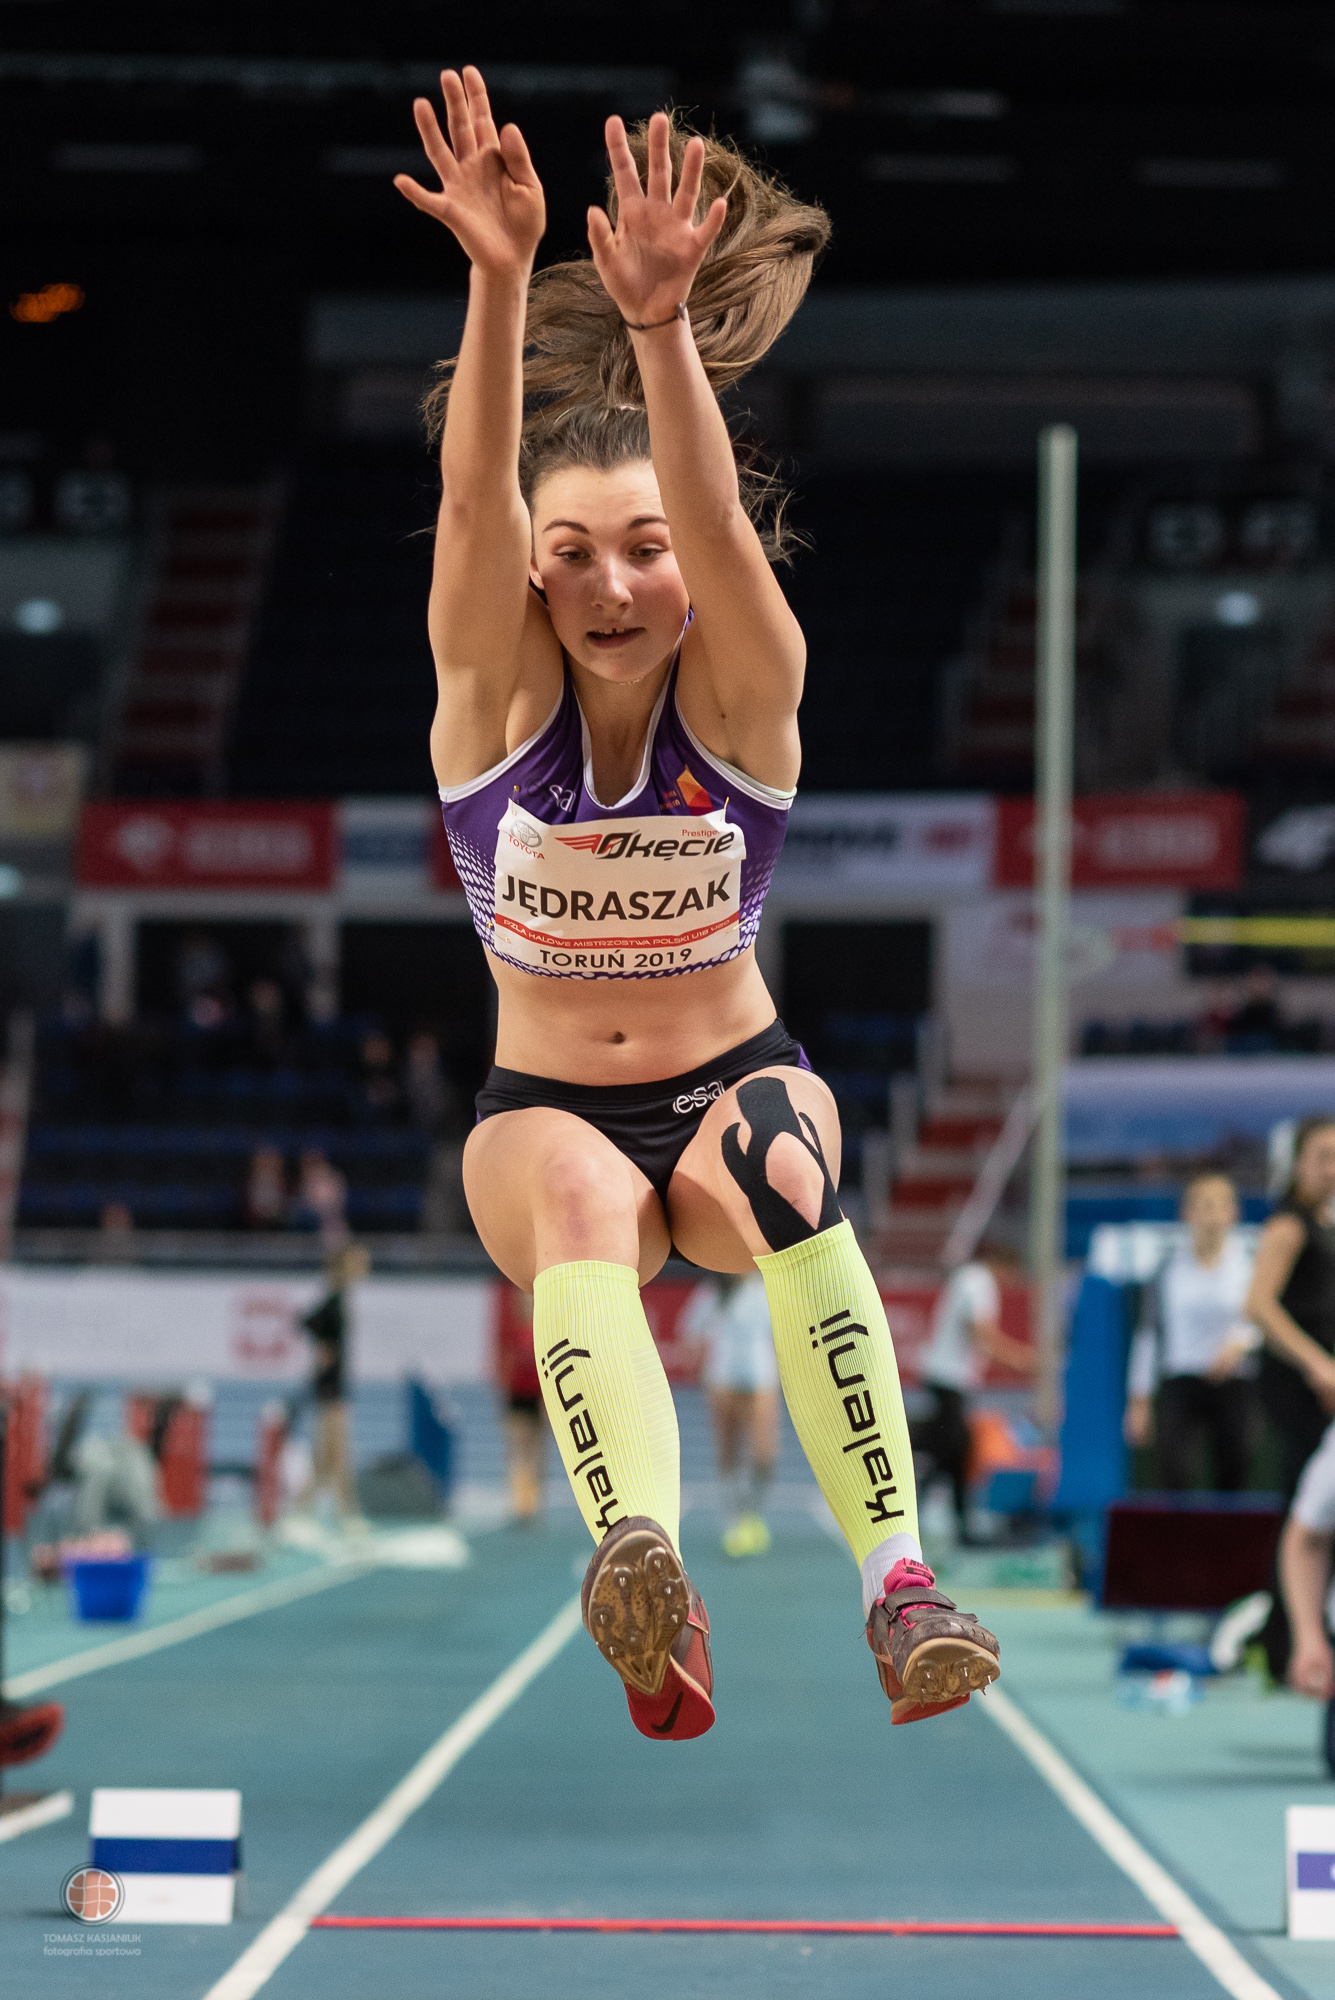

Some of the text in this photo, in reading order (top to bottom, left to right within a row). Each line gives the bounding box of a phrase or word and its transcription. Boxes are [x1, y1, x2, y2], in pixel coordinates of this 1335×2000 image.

[508, 833, 546, 860] TOYOTA
[502, 872, 731, 921] JĘDRASZAK
[503, 919, 527, 936] PZLA
[528, 932, 572, 947] HALOWE
[652, 935, 690, 945] POLSKI
[540, 948, 692, 968] TORUŃ 2019
[808, 1309, 905, 1524] kalenji
